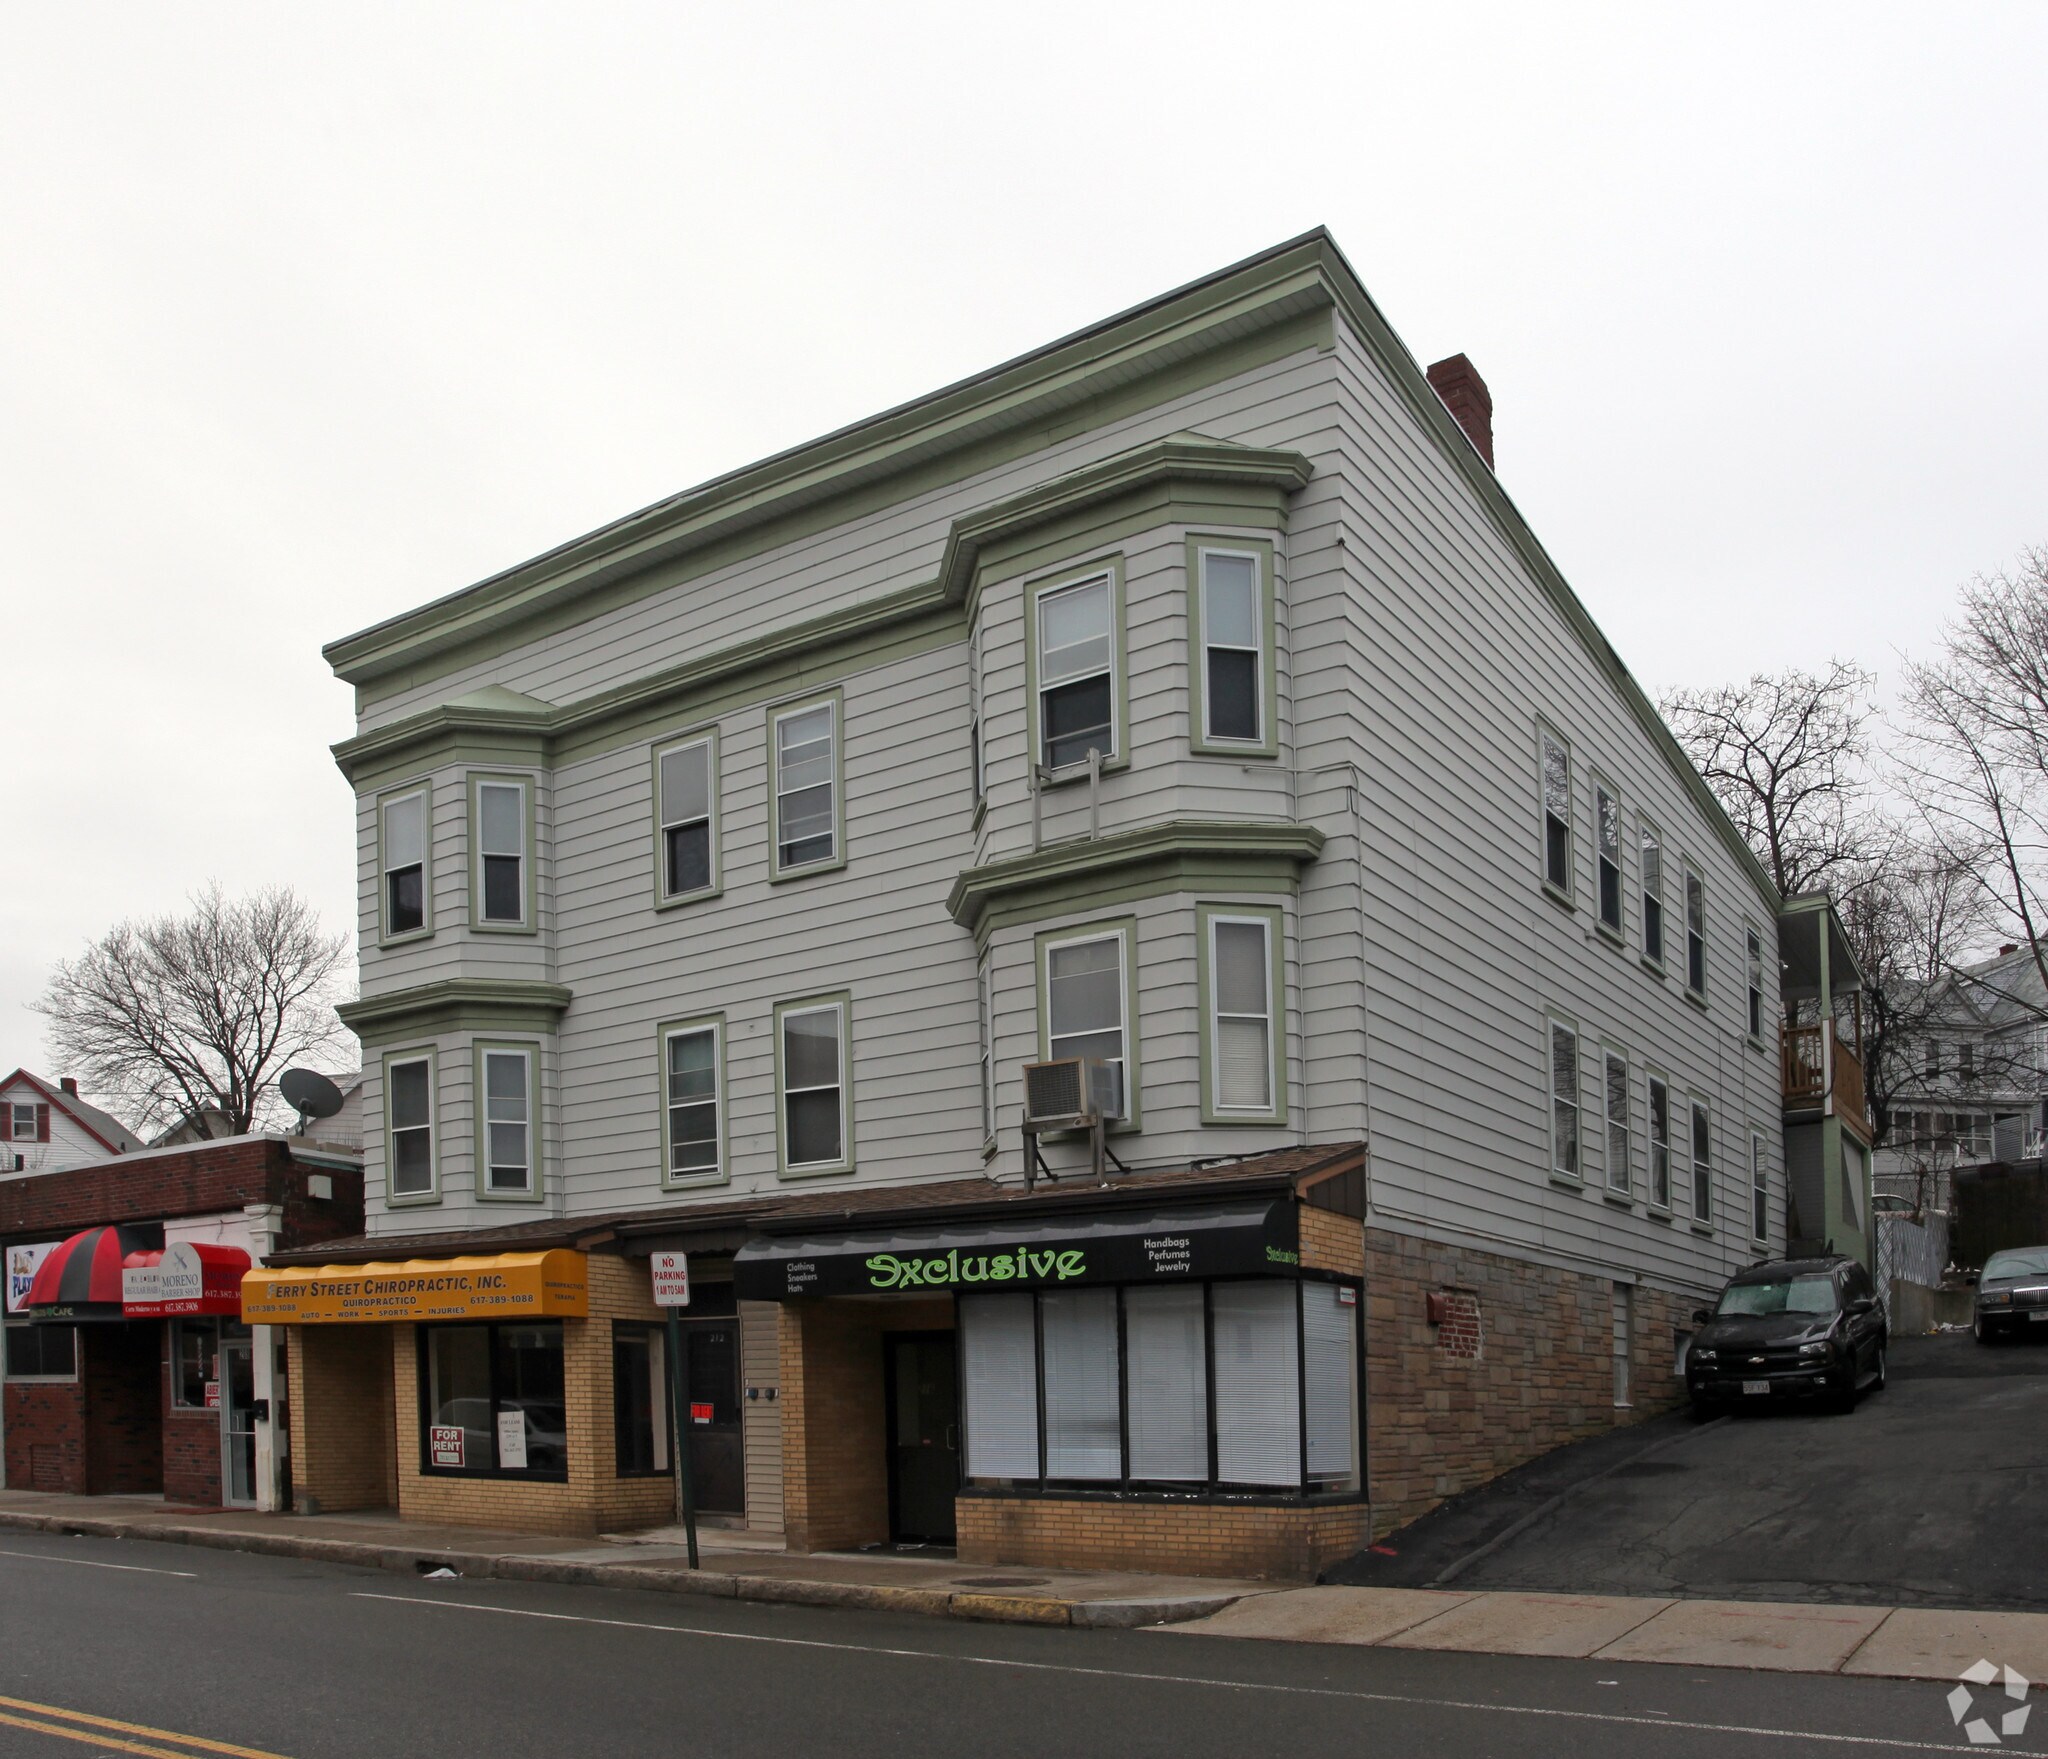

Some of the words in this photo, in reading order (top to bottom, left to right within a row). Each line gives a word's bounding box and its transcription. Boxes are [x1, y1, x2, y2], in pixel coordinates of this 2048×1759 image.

[1144, 1237, 1190, 1249] Handbags
[1148, 1249, 1190, 1260] Perfumes
[662, 1258, 675, 1268] NO
[786, 1261, 815, 1272] Clothing
[865, 1246, 1087, 1289] Exclusive
[1155, 1261, 1190, 1272] Jewelry
[161, 1274, 199, 1287] MORENO
[654, 1271, 686, 1280] PARKING
[787, 1272, 818, 1282] Sneakers
[13, 1276, 35, 1298] PLAY
[267, 1282, 307, 1299] FERRY
[311, 1281, 361, 1296] STREET
[364, 1277, 473, 1295] CHIROPRACTIC,
[477, 1275, 507, 1289] INC.
[668, 1285, 675, 1295] TO
[787, 1284, 803, 1293] Hats
[161, 1289, 184, 1298] BARBER
[185, 1287, 201, 1296] SHOP
[343, 1296, 417, 1307] QUIROPRACTICO
[470, 1295, 534, 1305] 617-389-1088
[247, 1304, 297, 1313] 617-389-1088
[428, 1307, 465, 1315] INJURIES
[710, 1334, 724, 1342] 212
[436, 1430, 458, 1440] FOR
[433, 1441, 461, 1451] RENT
